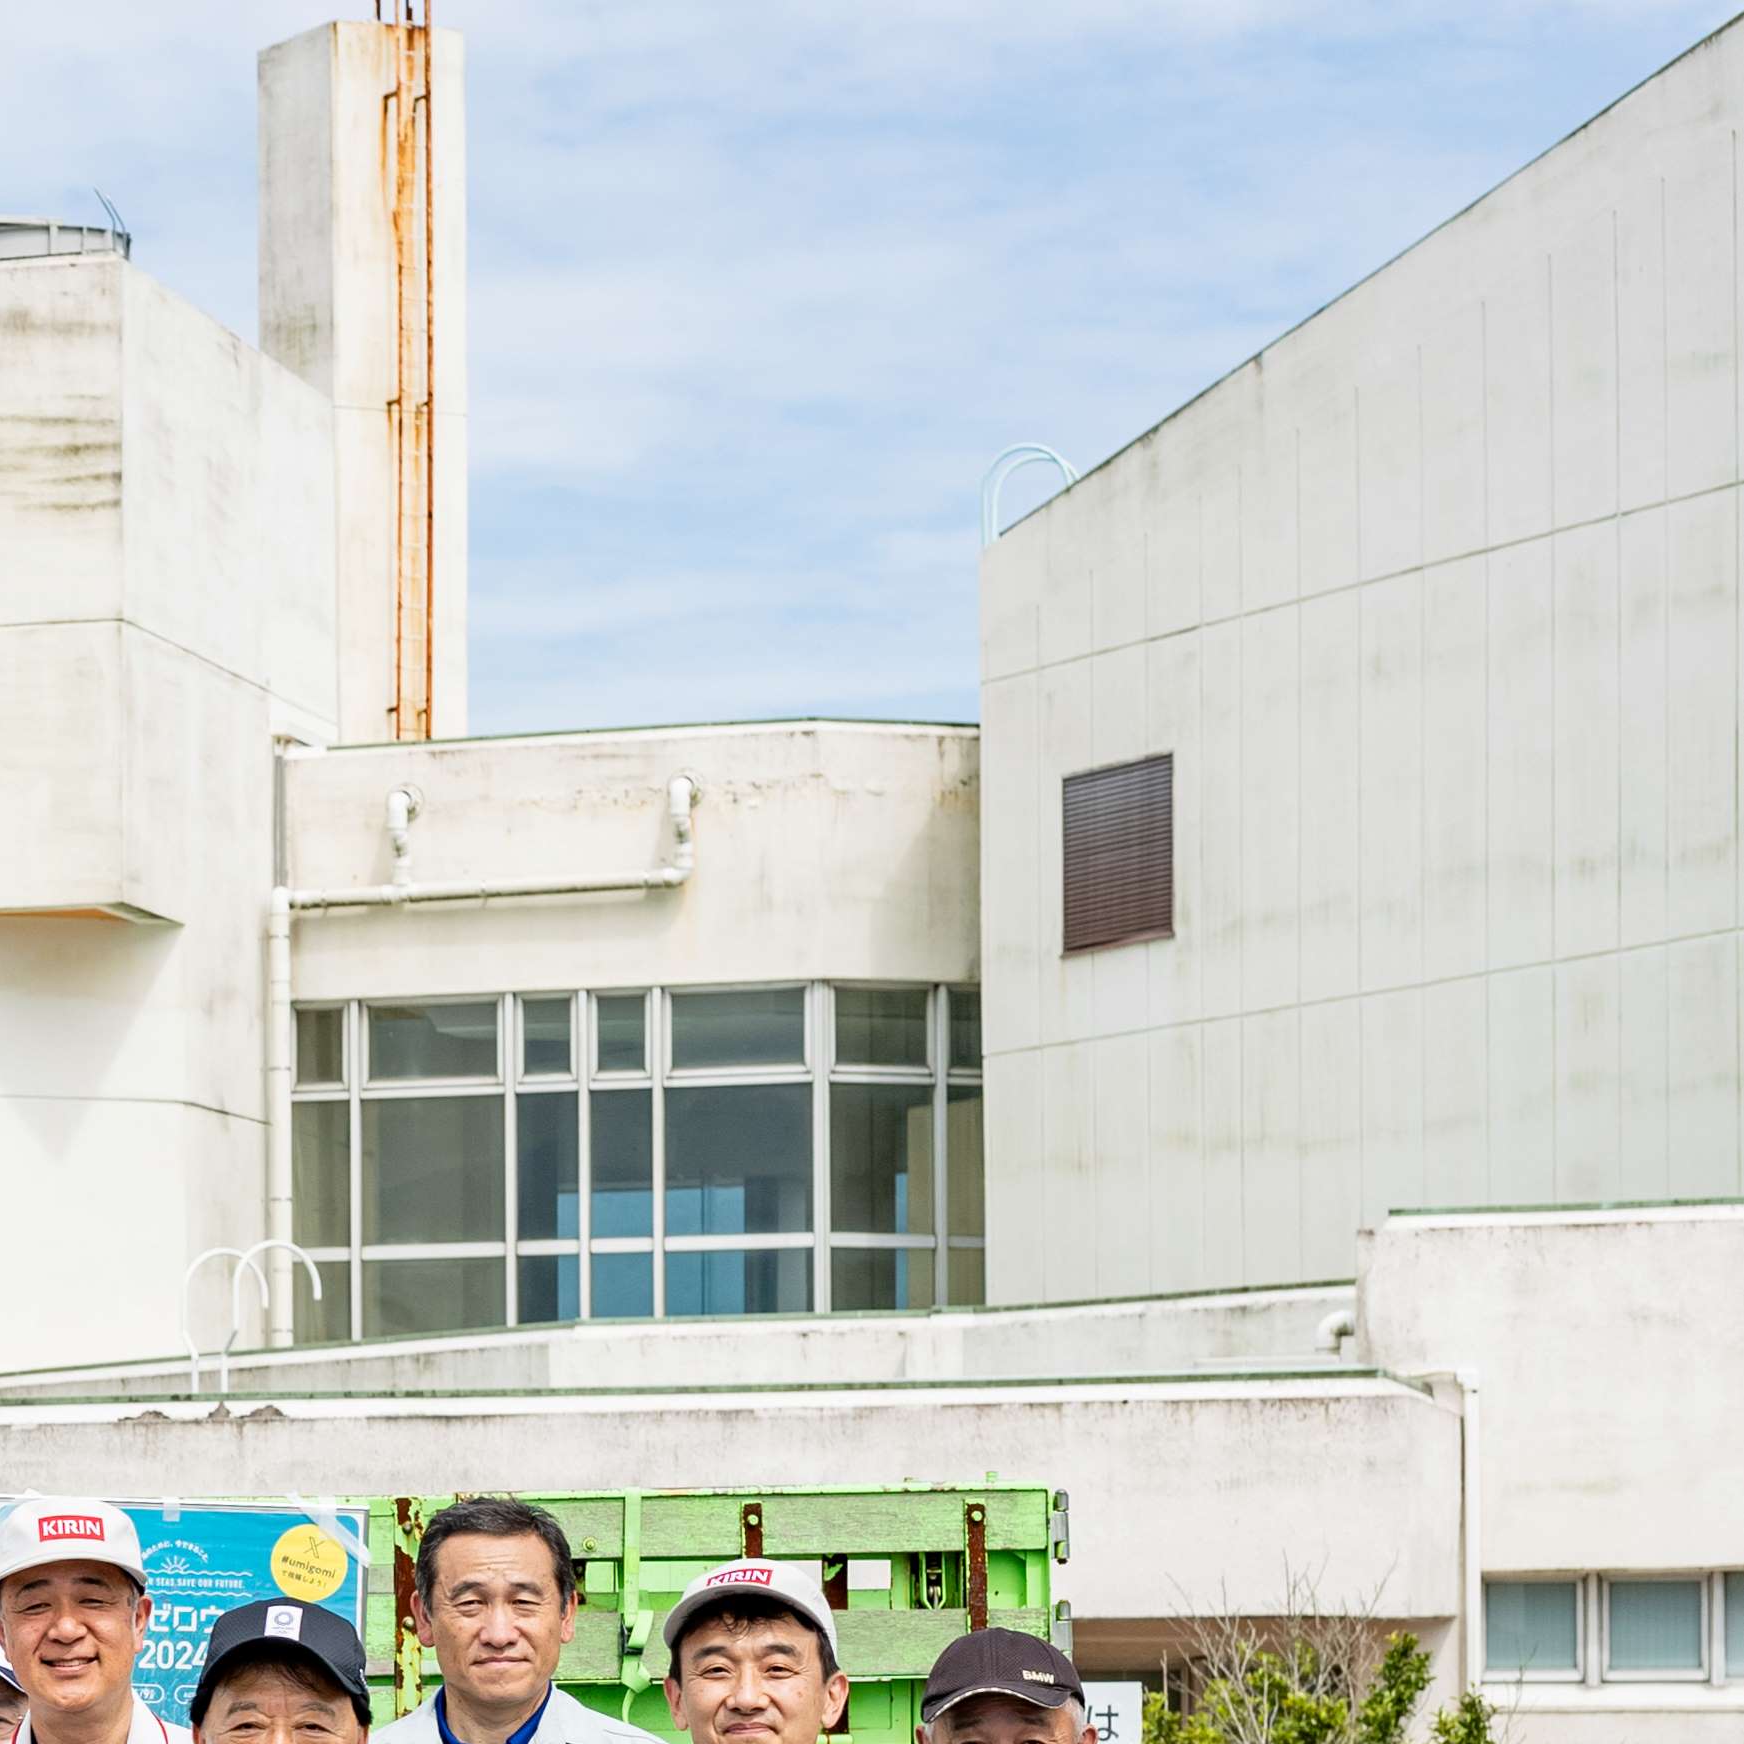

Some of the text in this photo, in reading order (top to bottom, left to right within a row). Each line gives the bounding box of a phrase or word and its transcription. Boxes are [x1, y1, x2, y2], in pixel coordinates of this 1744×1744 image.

[42, 1519, 101, 1537] KIRIN
[281, 1555, 336, 1579] #umigomi
[710, 1570, 768, 1585] KIRIN
[1022, 1669, 1055, 1685] BMW
